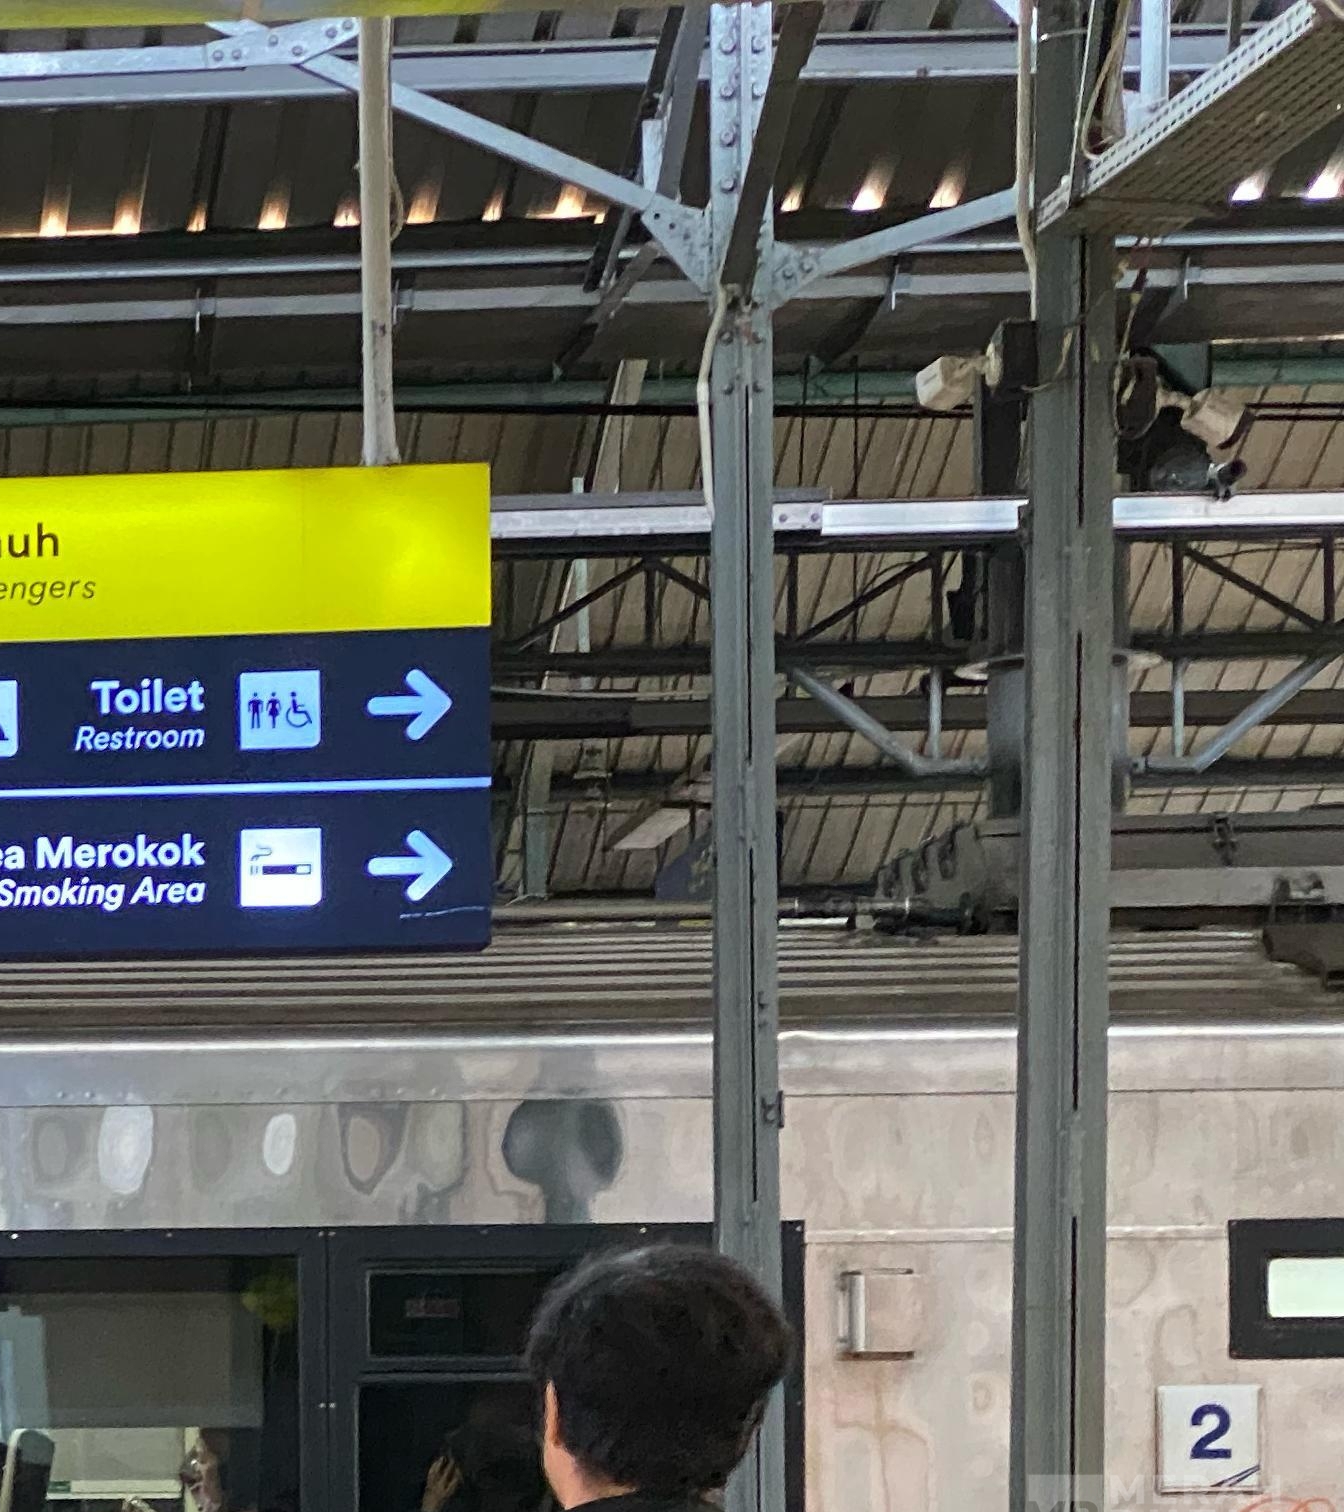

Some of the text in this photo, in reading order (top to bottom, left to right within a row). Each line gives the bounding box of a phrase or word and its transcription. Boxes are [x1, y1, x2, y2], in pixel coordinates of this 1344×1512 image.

[91, 678, 206, 714] Toilet
[75, 726, 205, 752] Restroom
[36, 833, 206, 870] Merokok
[131, 876, 205, 904] Area
[1189, 1403, 1233, 1460] 2
